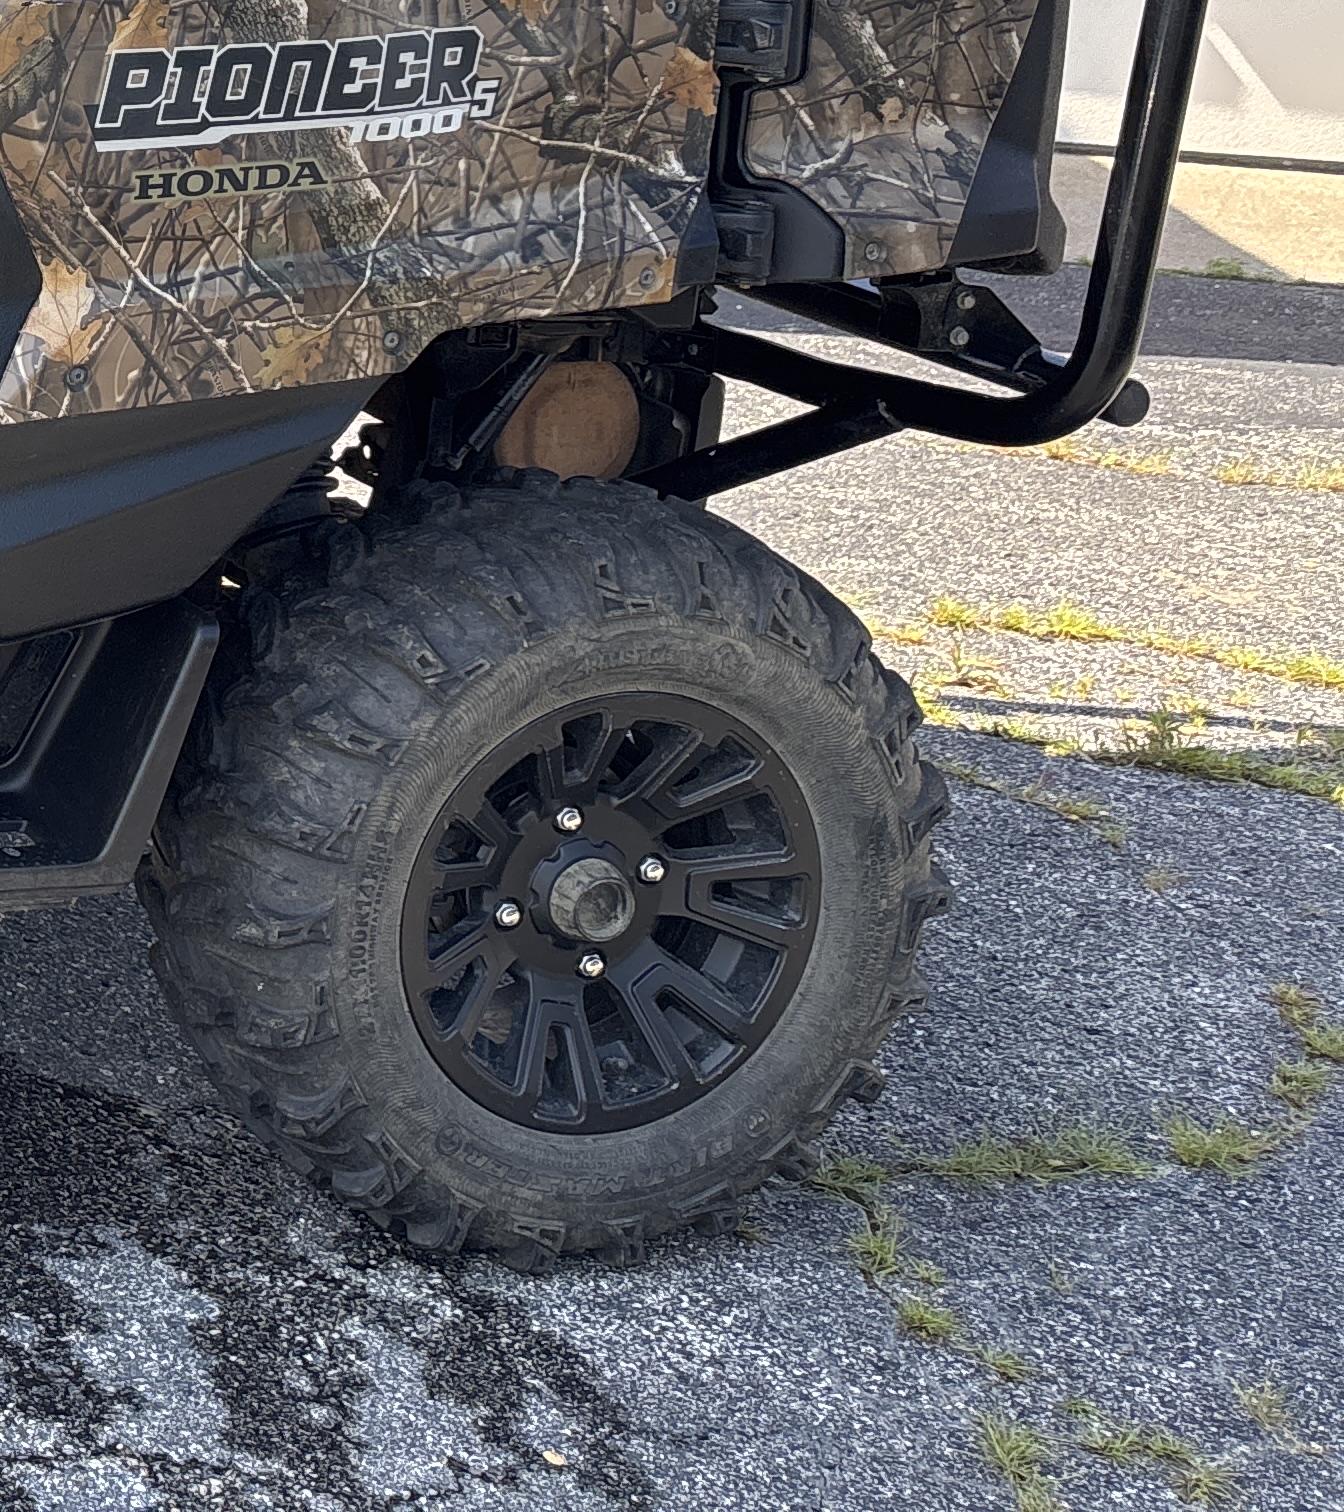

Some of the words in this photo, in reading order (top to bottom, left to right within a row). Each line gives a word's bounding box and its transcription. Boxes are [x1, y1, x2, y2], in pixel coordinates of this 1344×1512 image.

[94, 25, 485, 129] PIONEER
[349, 107, 464, 143] 1000
[133, 160, 328, 200] HONDA
